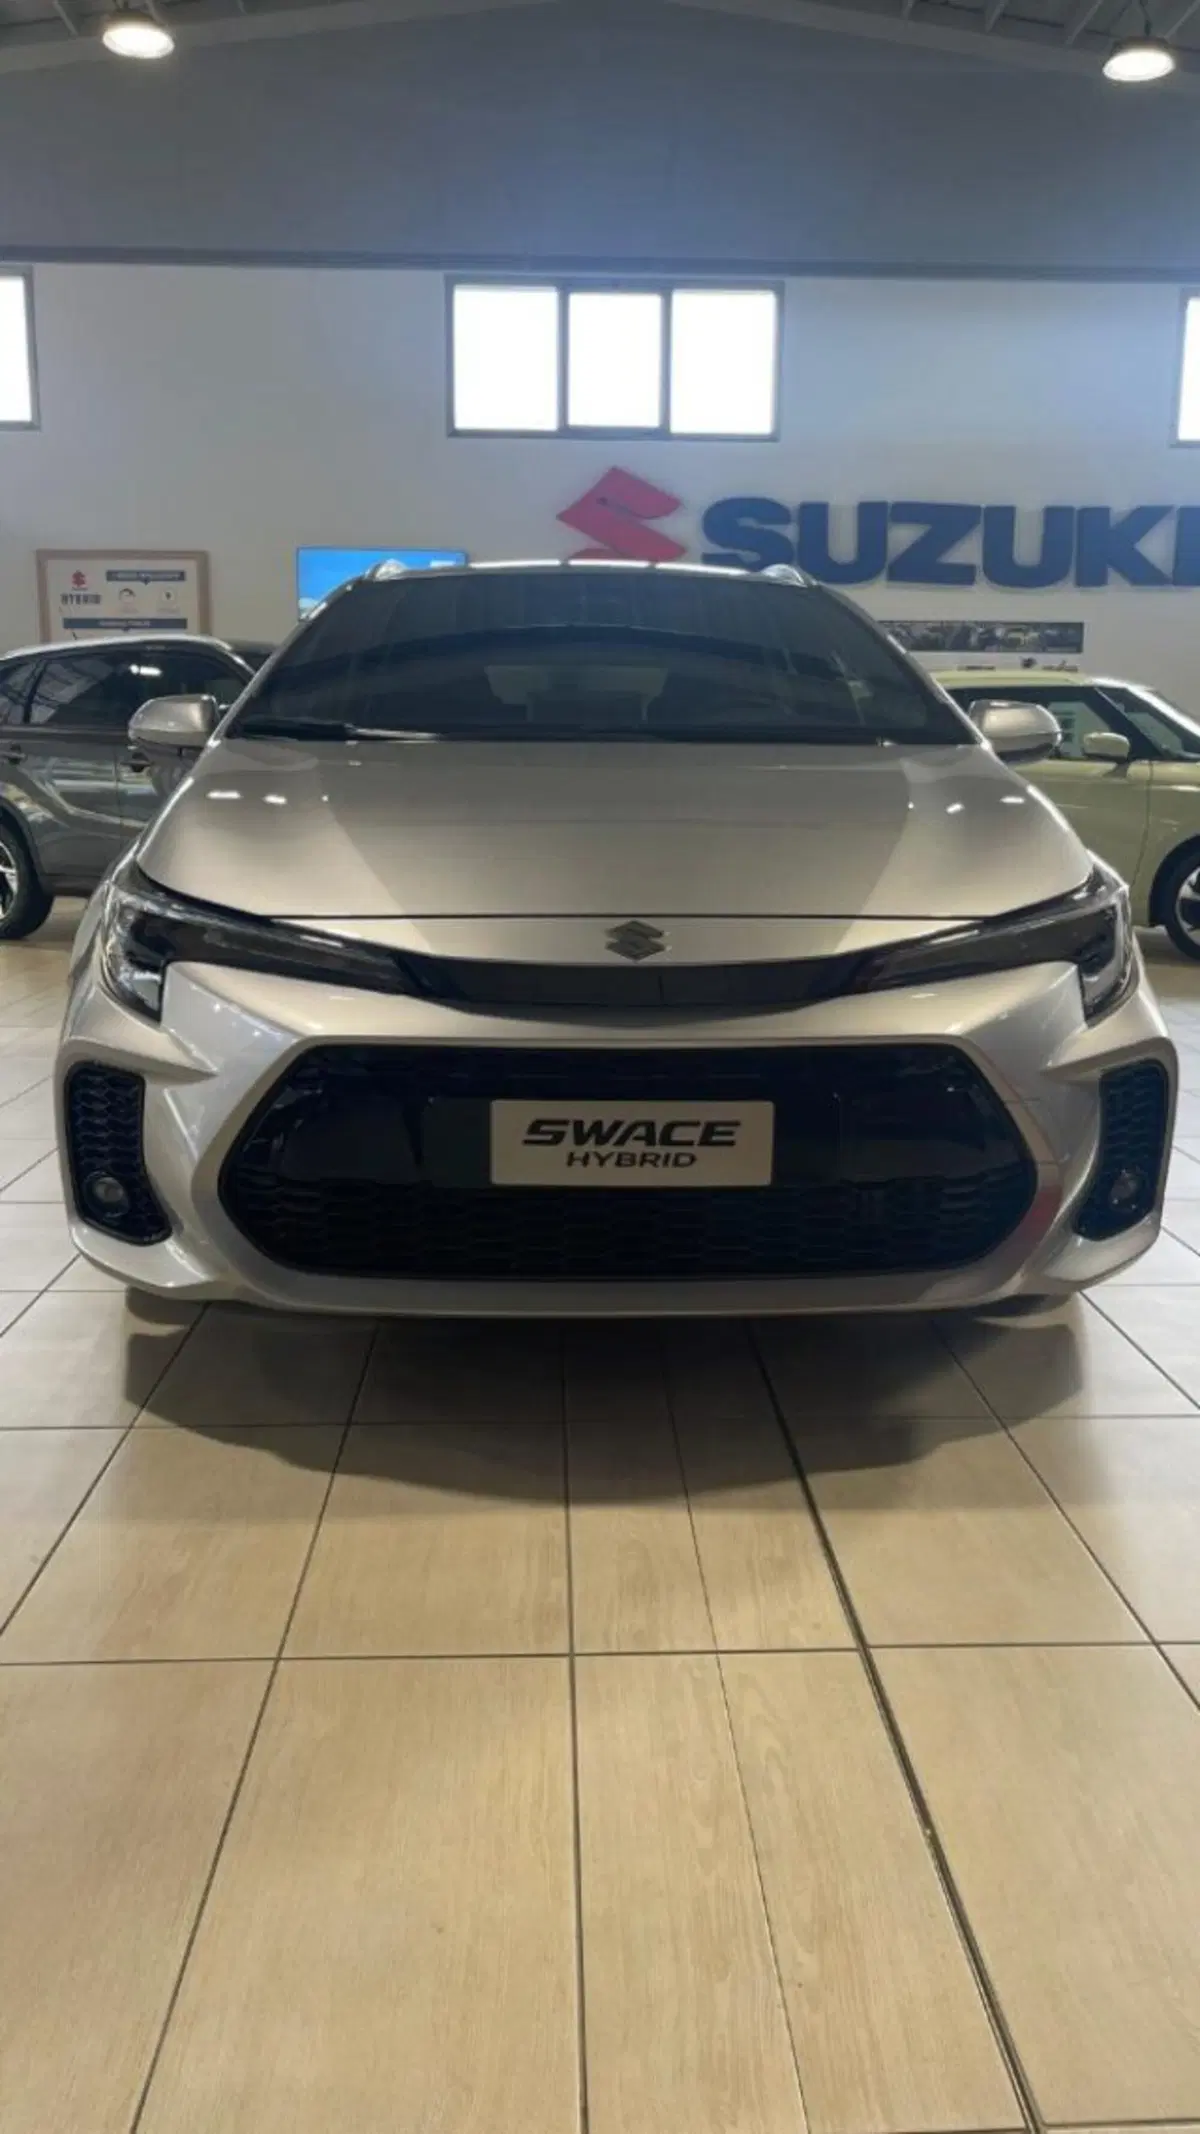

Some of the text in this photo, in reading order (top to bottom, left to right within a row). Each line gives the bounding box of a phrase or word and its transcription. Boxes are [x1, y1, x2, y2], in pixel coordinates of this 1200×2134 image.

[702, 497, 1200, 588] SUZUKI
[522, 1119, 741, 1147] SWACE
[566, 1151, 697, 1168] HYBRID
